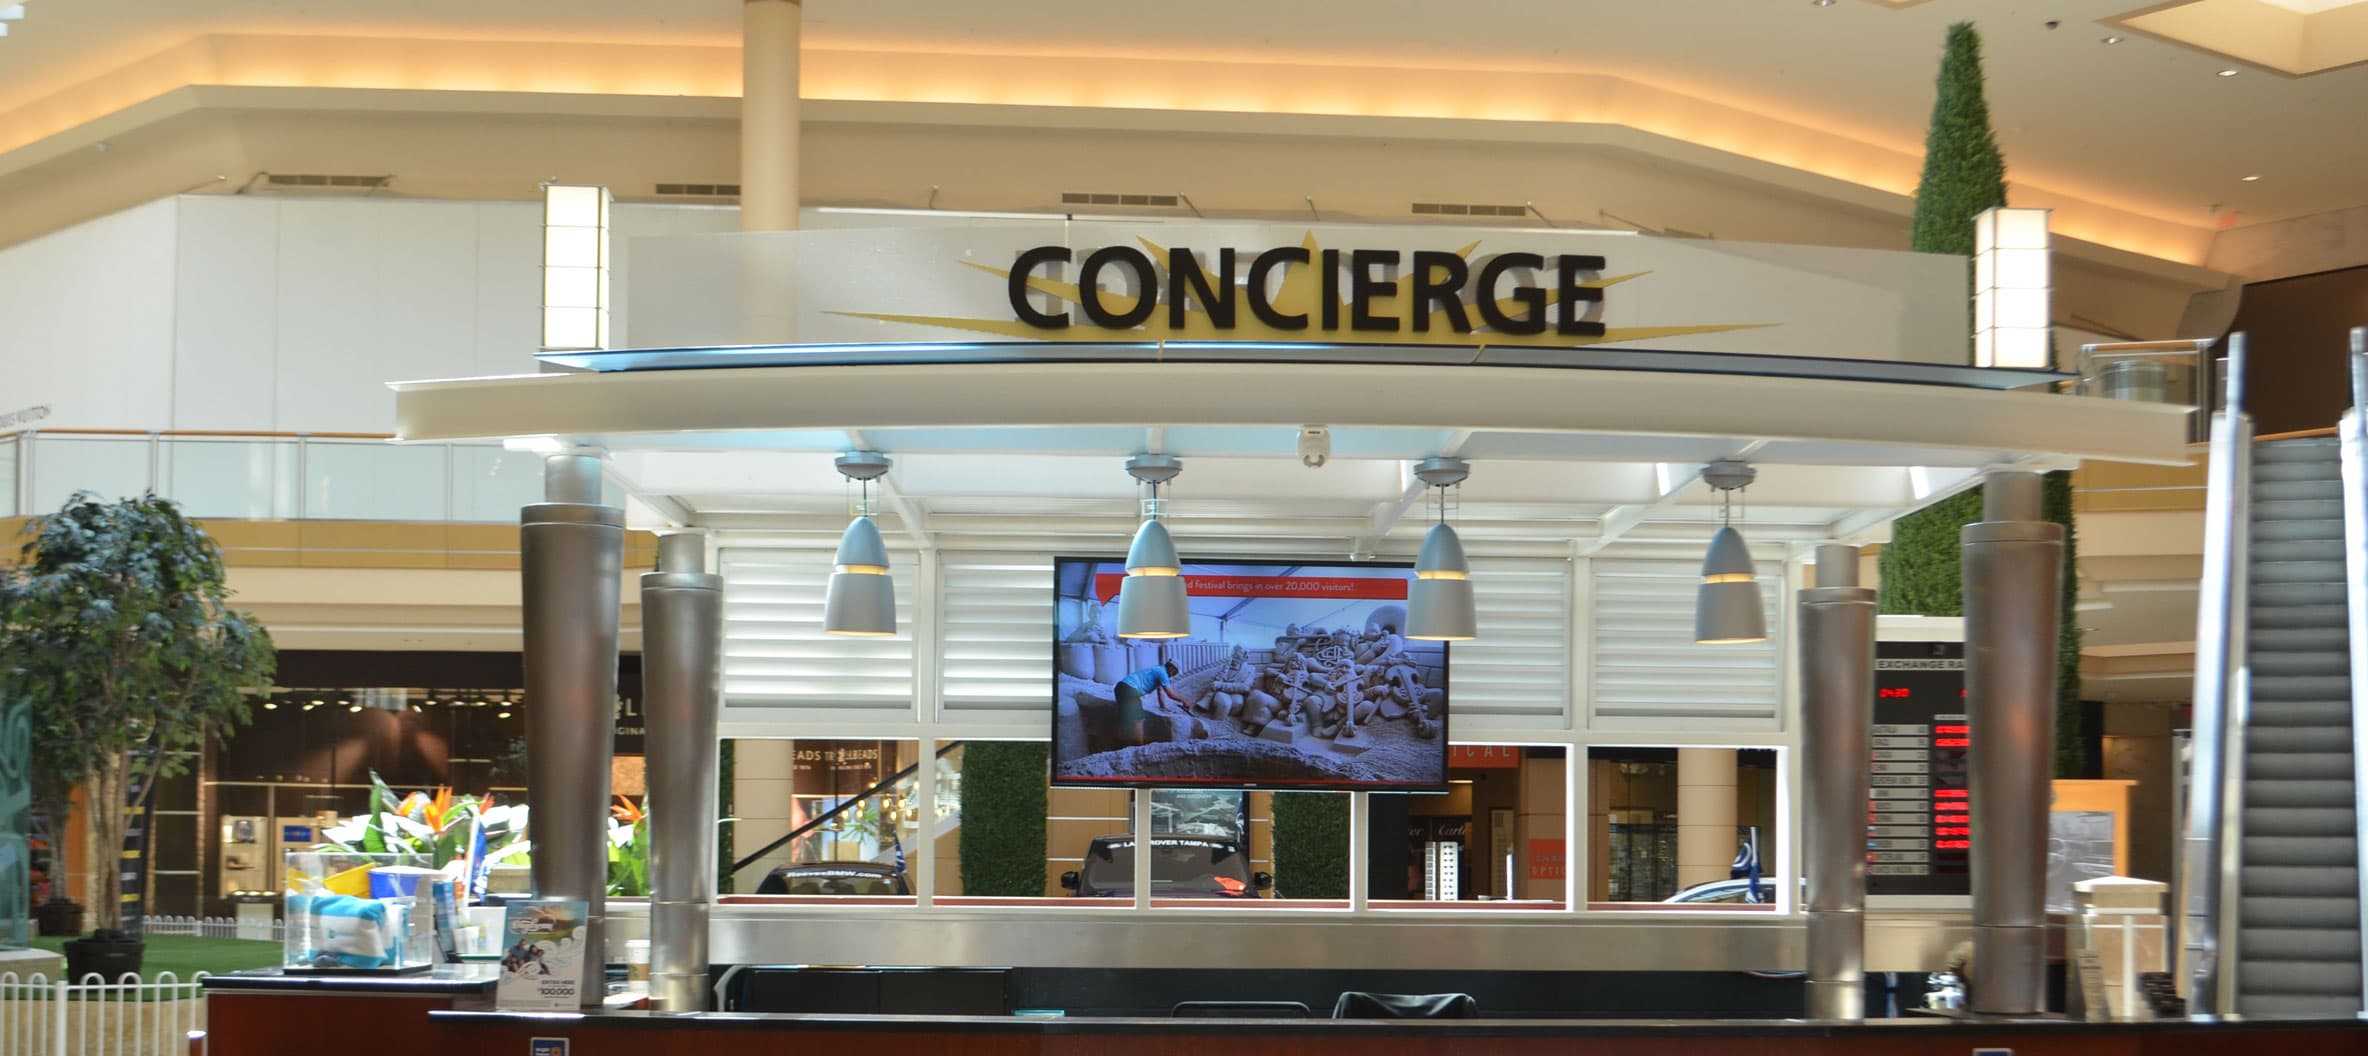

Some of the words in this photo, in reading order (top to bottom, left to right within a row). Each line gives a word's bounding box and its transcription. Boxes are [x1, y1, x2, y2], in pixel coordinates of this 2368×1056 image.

[1007, 245, 1607, 337] CONCIERGE
[1195, 580, 1226, 589] festival
[1227, 581, 1253, 592] brings
[1265, 583, 1284, 591] over
[1285, 580, 1320, 592] 20,000
[1878, 660, 1945, 668] EXCHANGE
